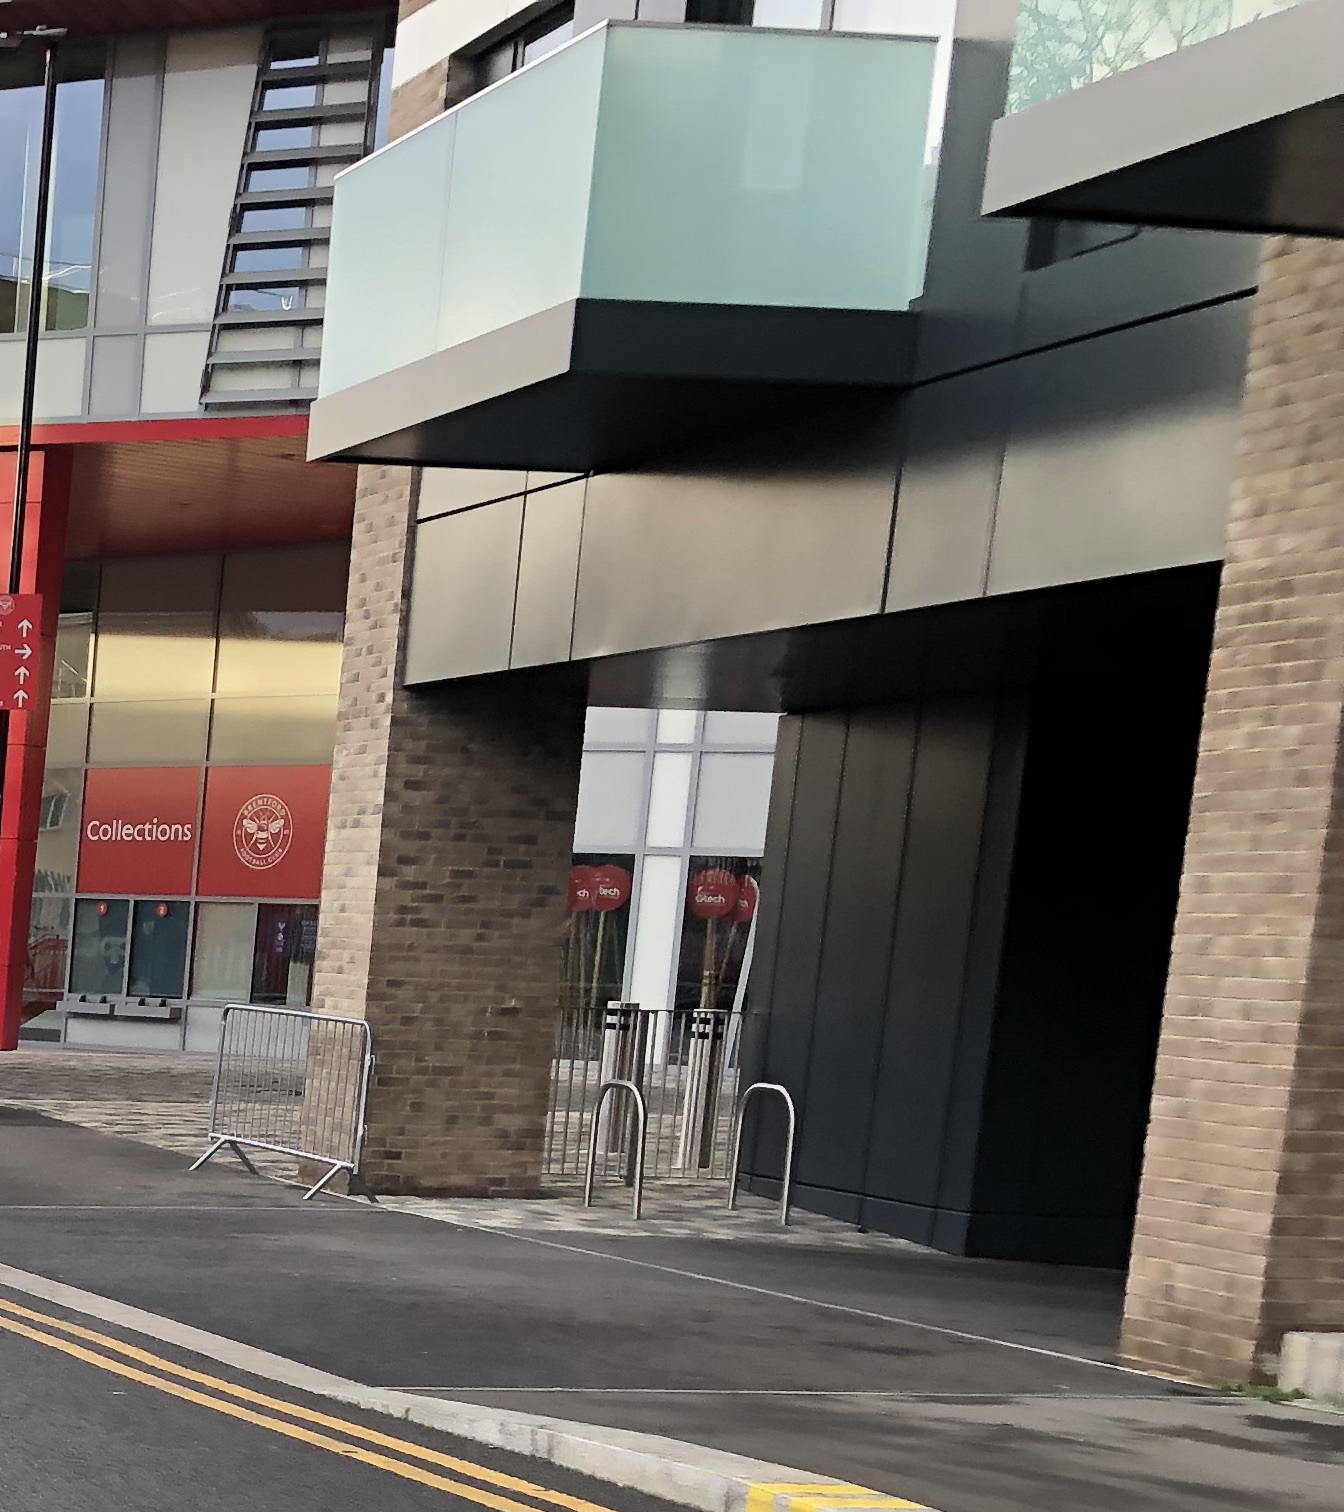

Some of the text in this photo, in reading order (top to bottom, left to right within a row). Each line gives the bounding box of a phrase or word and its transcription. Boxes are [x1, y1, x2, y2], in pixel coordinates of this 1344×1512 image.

[243, 798, 286, 816] BRENTFORD
[86, 817, 192, 842] Collections
[240, 847, 283, 866] FOOTBALL CLUB
